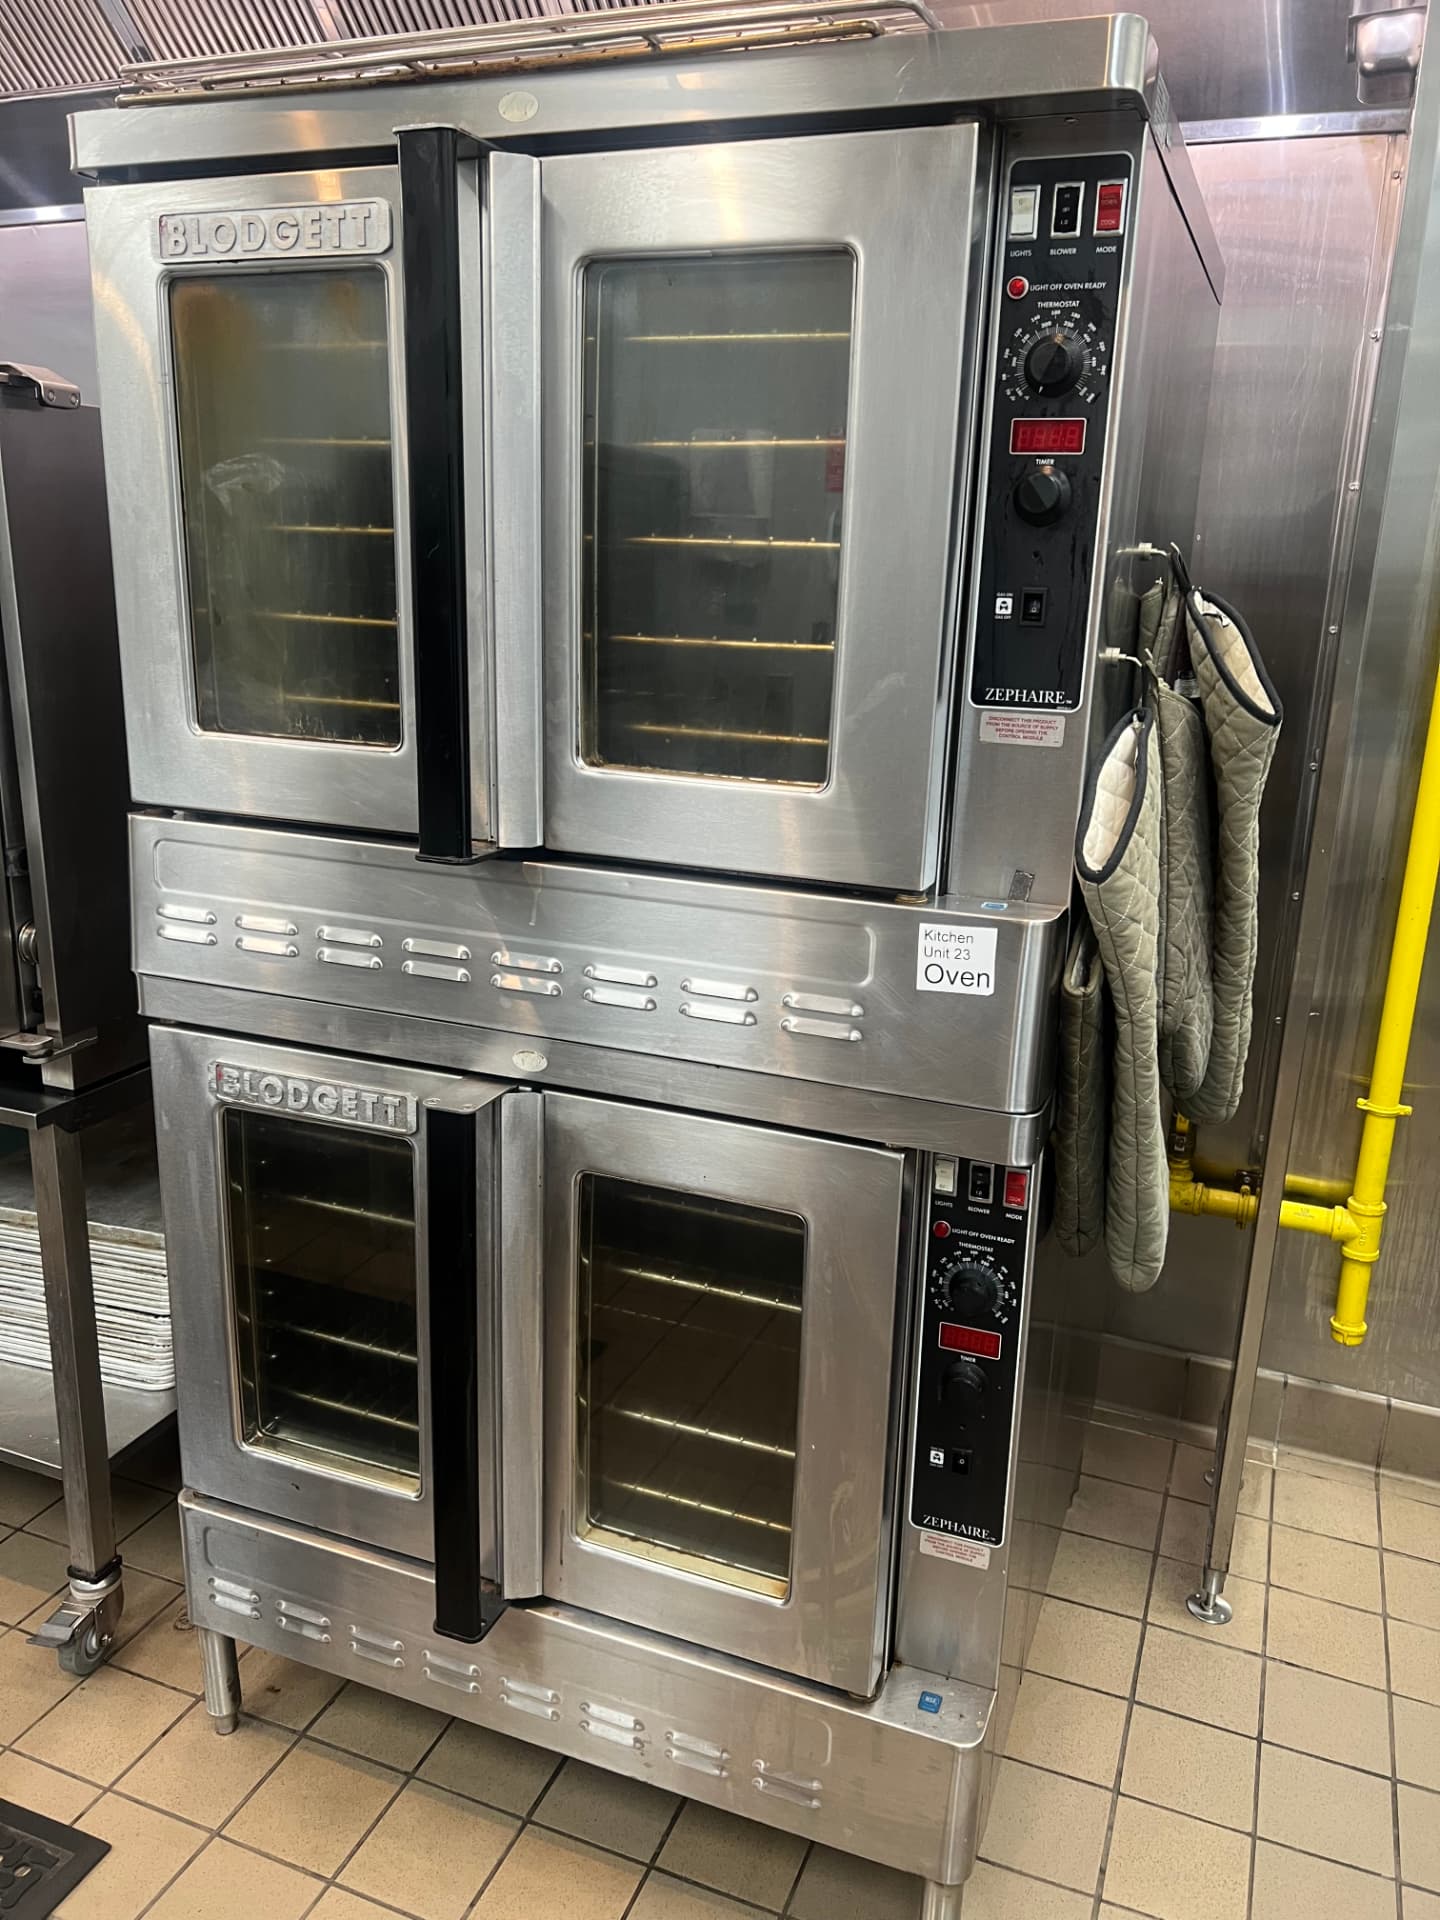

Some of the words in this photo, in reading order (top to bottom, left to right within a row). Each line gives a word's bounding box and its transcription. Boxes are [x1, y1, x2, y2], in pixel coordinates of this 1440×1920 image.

[167, 207, 371, 256] BLODGETT
[1010, 249, 1032, 257] LIGHTS
[1049, 248, 1077, 256] BLOWER
[1096, 245, 1117, 253] MODE
[1029, 283, 1048, 291] LIGHT
[1063, 282, 1084, 290] OVEN
[1037, 300, 1080, 309] THERMOSTAT
[985, 687, 1065, 704] ZEPHAIRE
[924, 929, 974, 944] Kitchen
[924, 946, 950, 959] Unit
[954, 948, 971, 960] 23
[924, 963, 990, 988] Oven
[222, 1066, 401, 1126] BLODGETT
[934, 1200, 953, 1208] LIGHTS
[967, 1206, 990, 1214] BLOWER
[979, 1232, 997, 1241] OVEN
[996, 1236, 1015, 1244] READY
[959, 1241, 994, 1252] THERMOSTAT
[960, 1354, 976, 1363] TIMER
[922, 1514, 990, 1540] ZEPHAIRE
